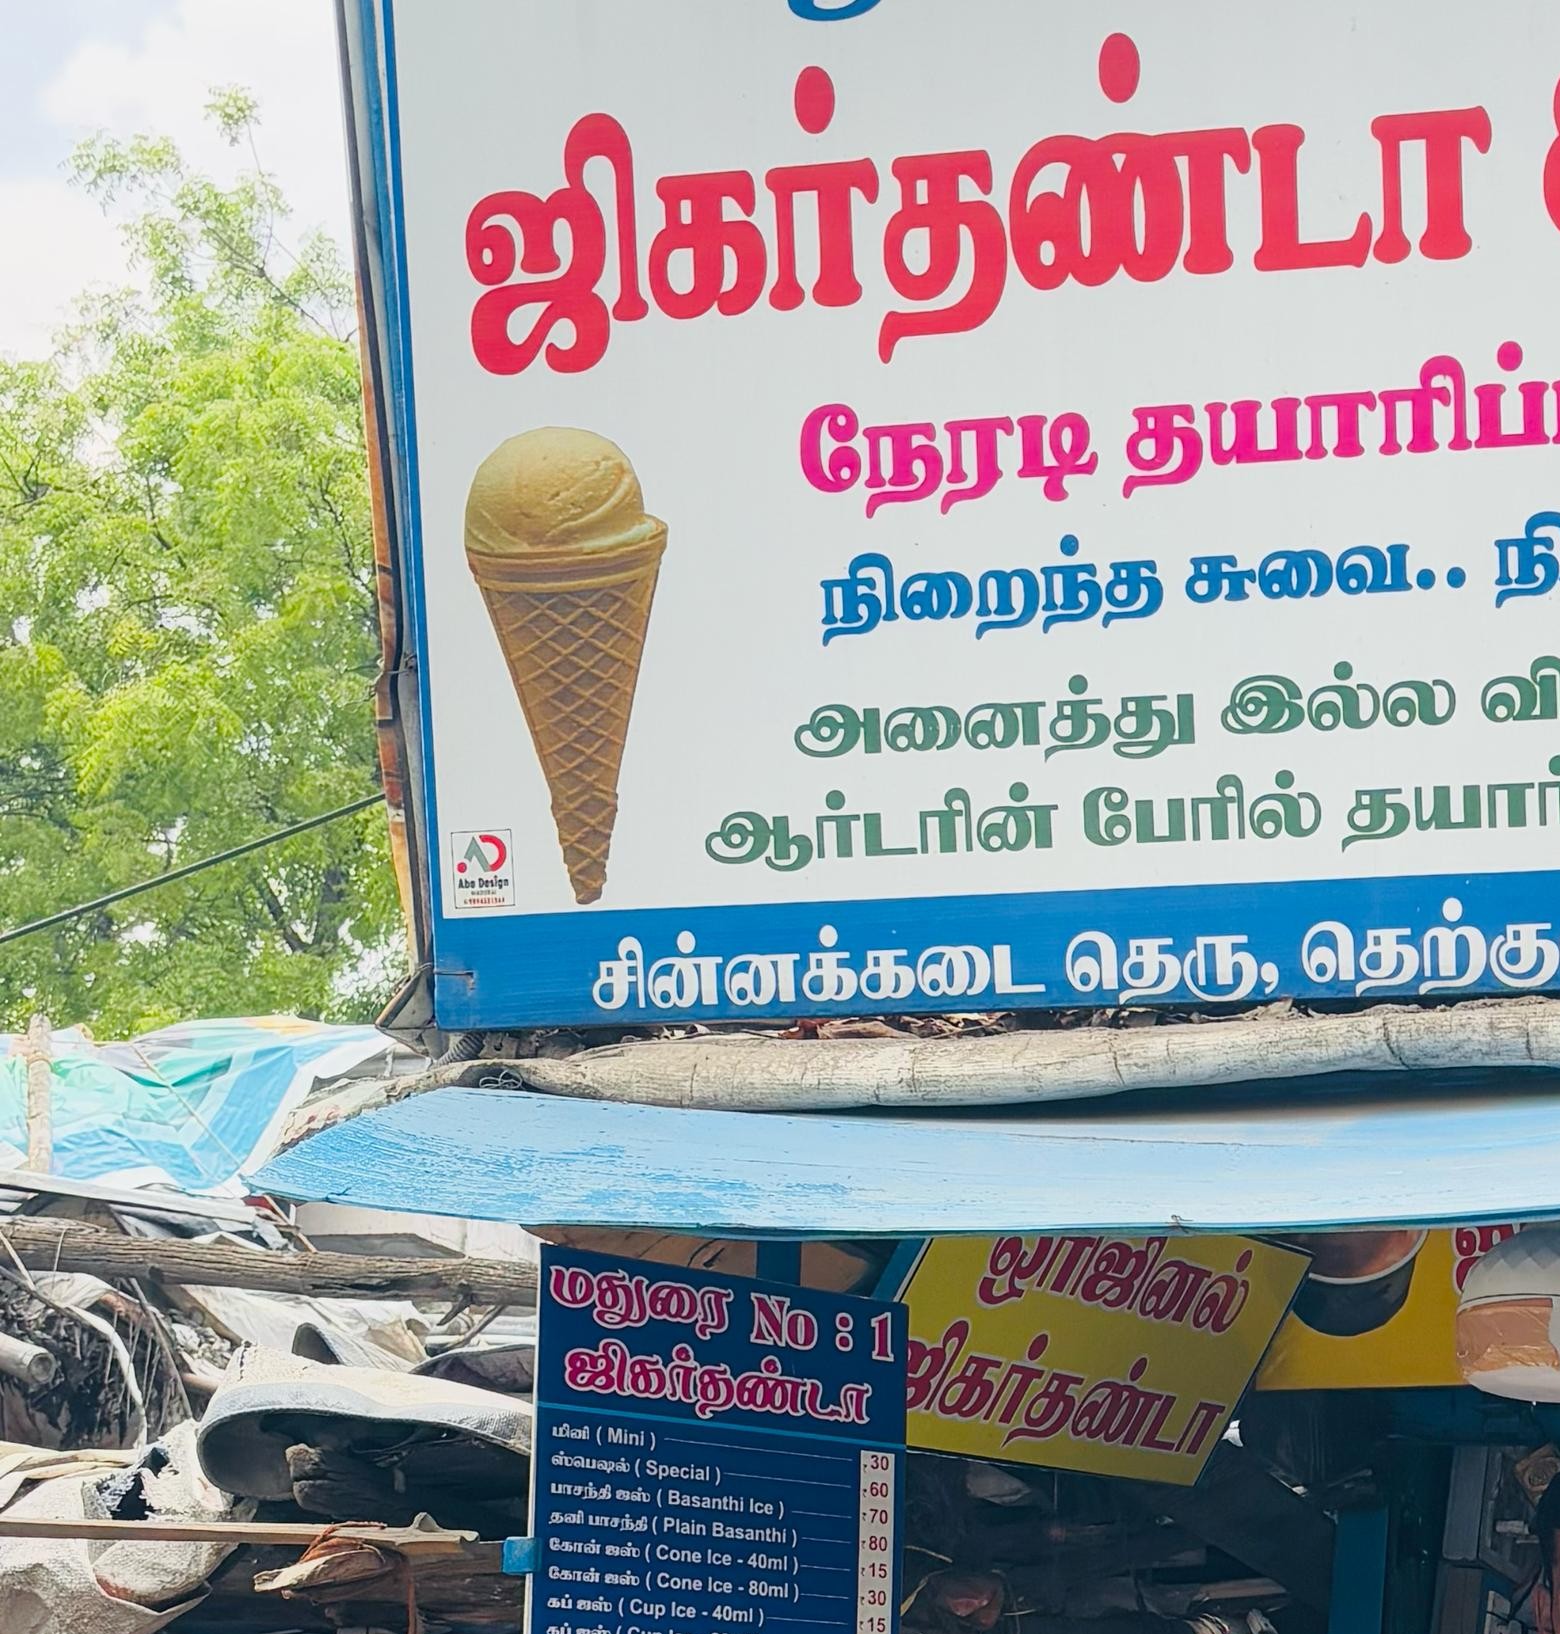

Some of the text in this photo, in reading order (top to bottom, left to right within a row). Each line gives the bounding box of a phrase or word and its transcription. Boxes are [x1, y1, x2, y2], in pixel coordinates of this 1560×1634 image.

[465, 33, 1492, 375] ஜிகர்தண்டா
[800, 403, 1098, 518] நேரடி
[821, 534, 1162, 646] நிறைந்த
[794, 674, 1195, 761] அனைத்து
[1221, 661, 1455, 735] இல்ல
[706, 782, 1058, 872] ஆர்டரின்
[1083, 769, 1321, 847] பேரில்
[592, 925, 1045, 1011] சின்னக்கடை
[1066, 930, 1279, 1002] தெரு,
[549, 1265, 732, 1339] மதுரை
[750, 1294, 818, 1351] No
[871, 1312, 894, 1361] 1
[565, 1339, 871, 1424] ஜிகர்தண்டா
[552, 1423, 590, 1440] மினி
[552, 1451, 630, 1473] ஸ்பெஷல்
[549, 1510, 584, 1524] தனி
[588, 1514, 648, 1532] பாசந்தி
[551, 1482, 611, 1500] பாசந்தி
[549, 1537, 601, 1554] கோன்
[707, 1549, 732, 1565] Ice
[549, 1566, 600, 1583] கோன்
[708, 1577, 732, 1593] Ice
[547, 1594, 572, 1609] கப்
[671, 1602, 696, 1618] Ice
